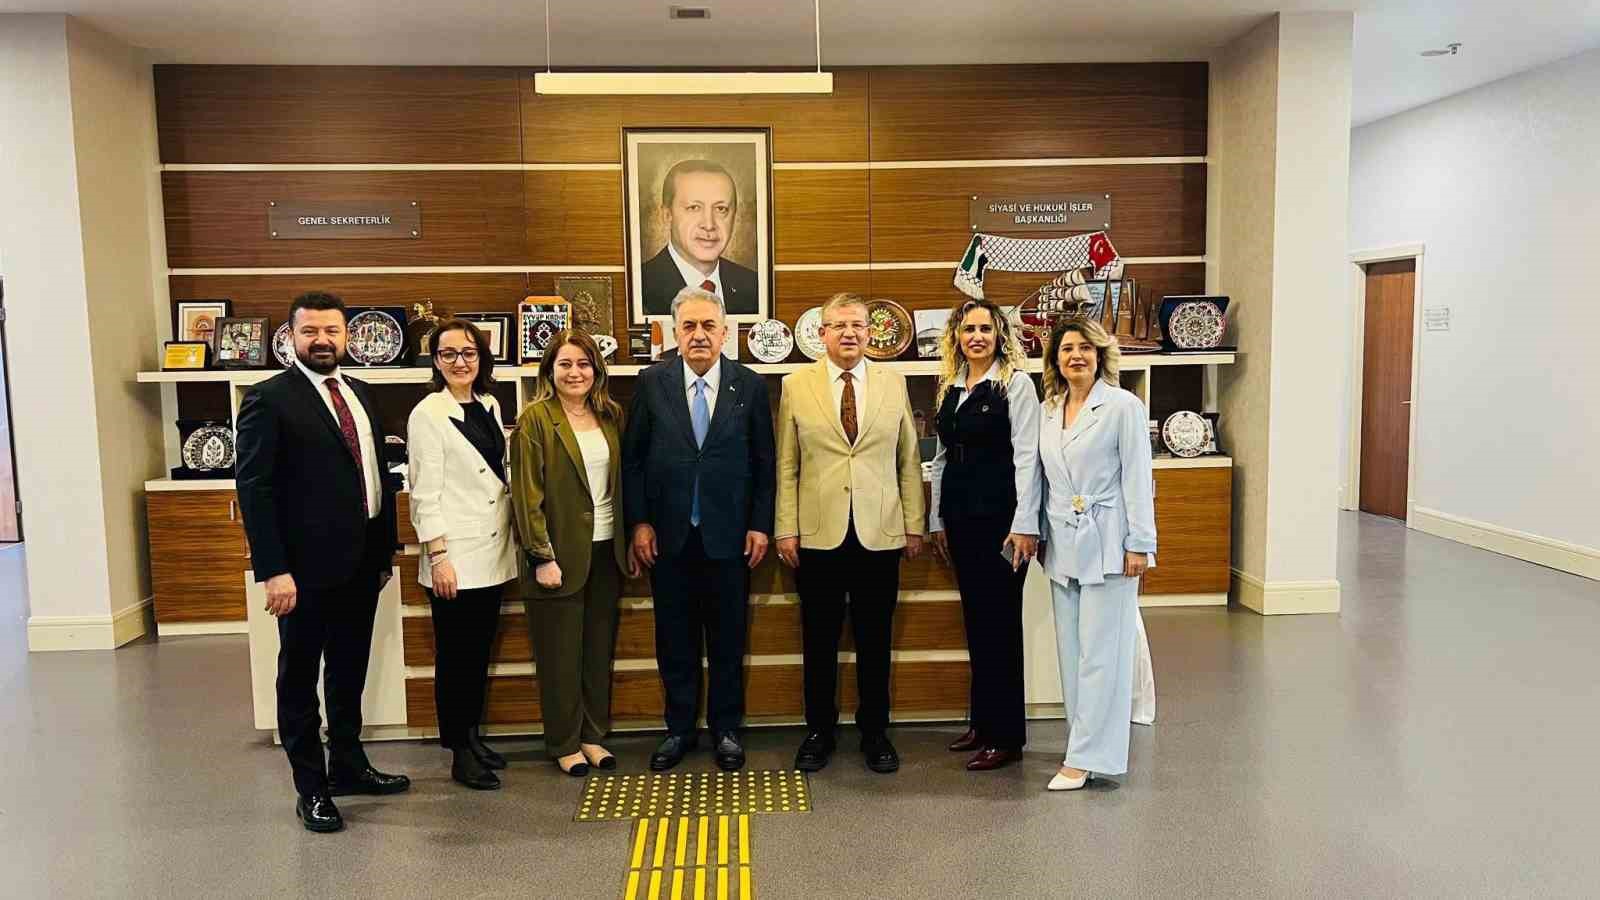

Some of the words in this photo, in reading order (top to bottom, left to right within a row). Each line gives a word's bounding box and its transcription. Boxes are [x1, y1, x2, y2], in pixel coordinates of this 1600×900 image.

[989, 203, 1017, 212] SİYASİ
[1020, 203, 1031, 212] VE
[1033, 202, 1067, 212] HUKUKİ
[1069, 202, 1093, 213] İŞLER
[297, 216, 328, 225] GENEL
[330, 215, 391, 225] SEKRETERLİK
[1014, 213, 1067, 224] BAŞKANLIĞI
